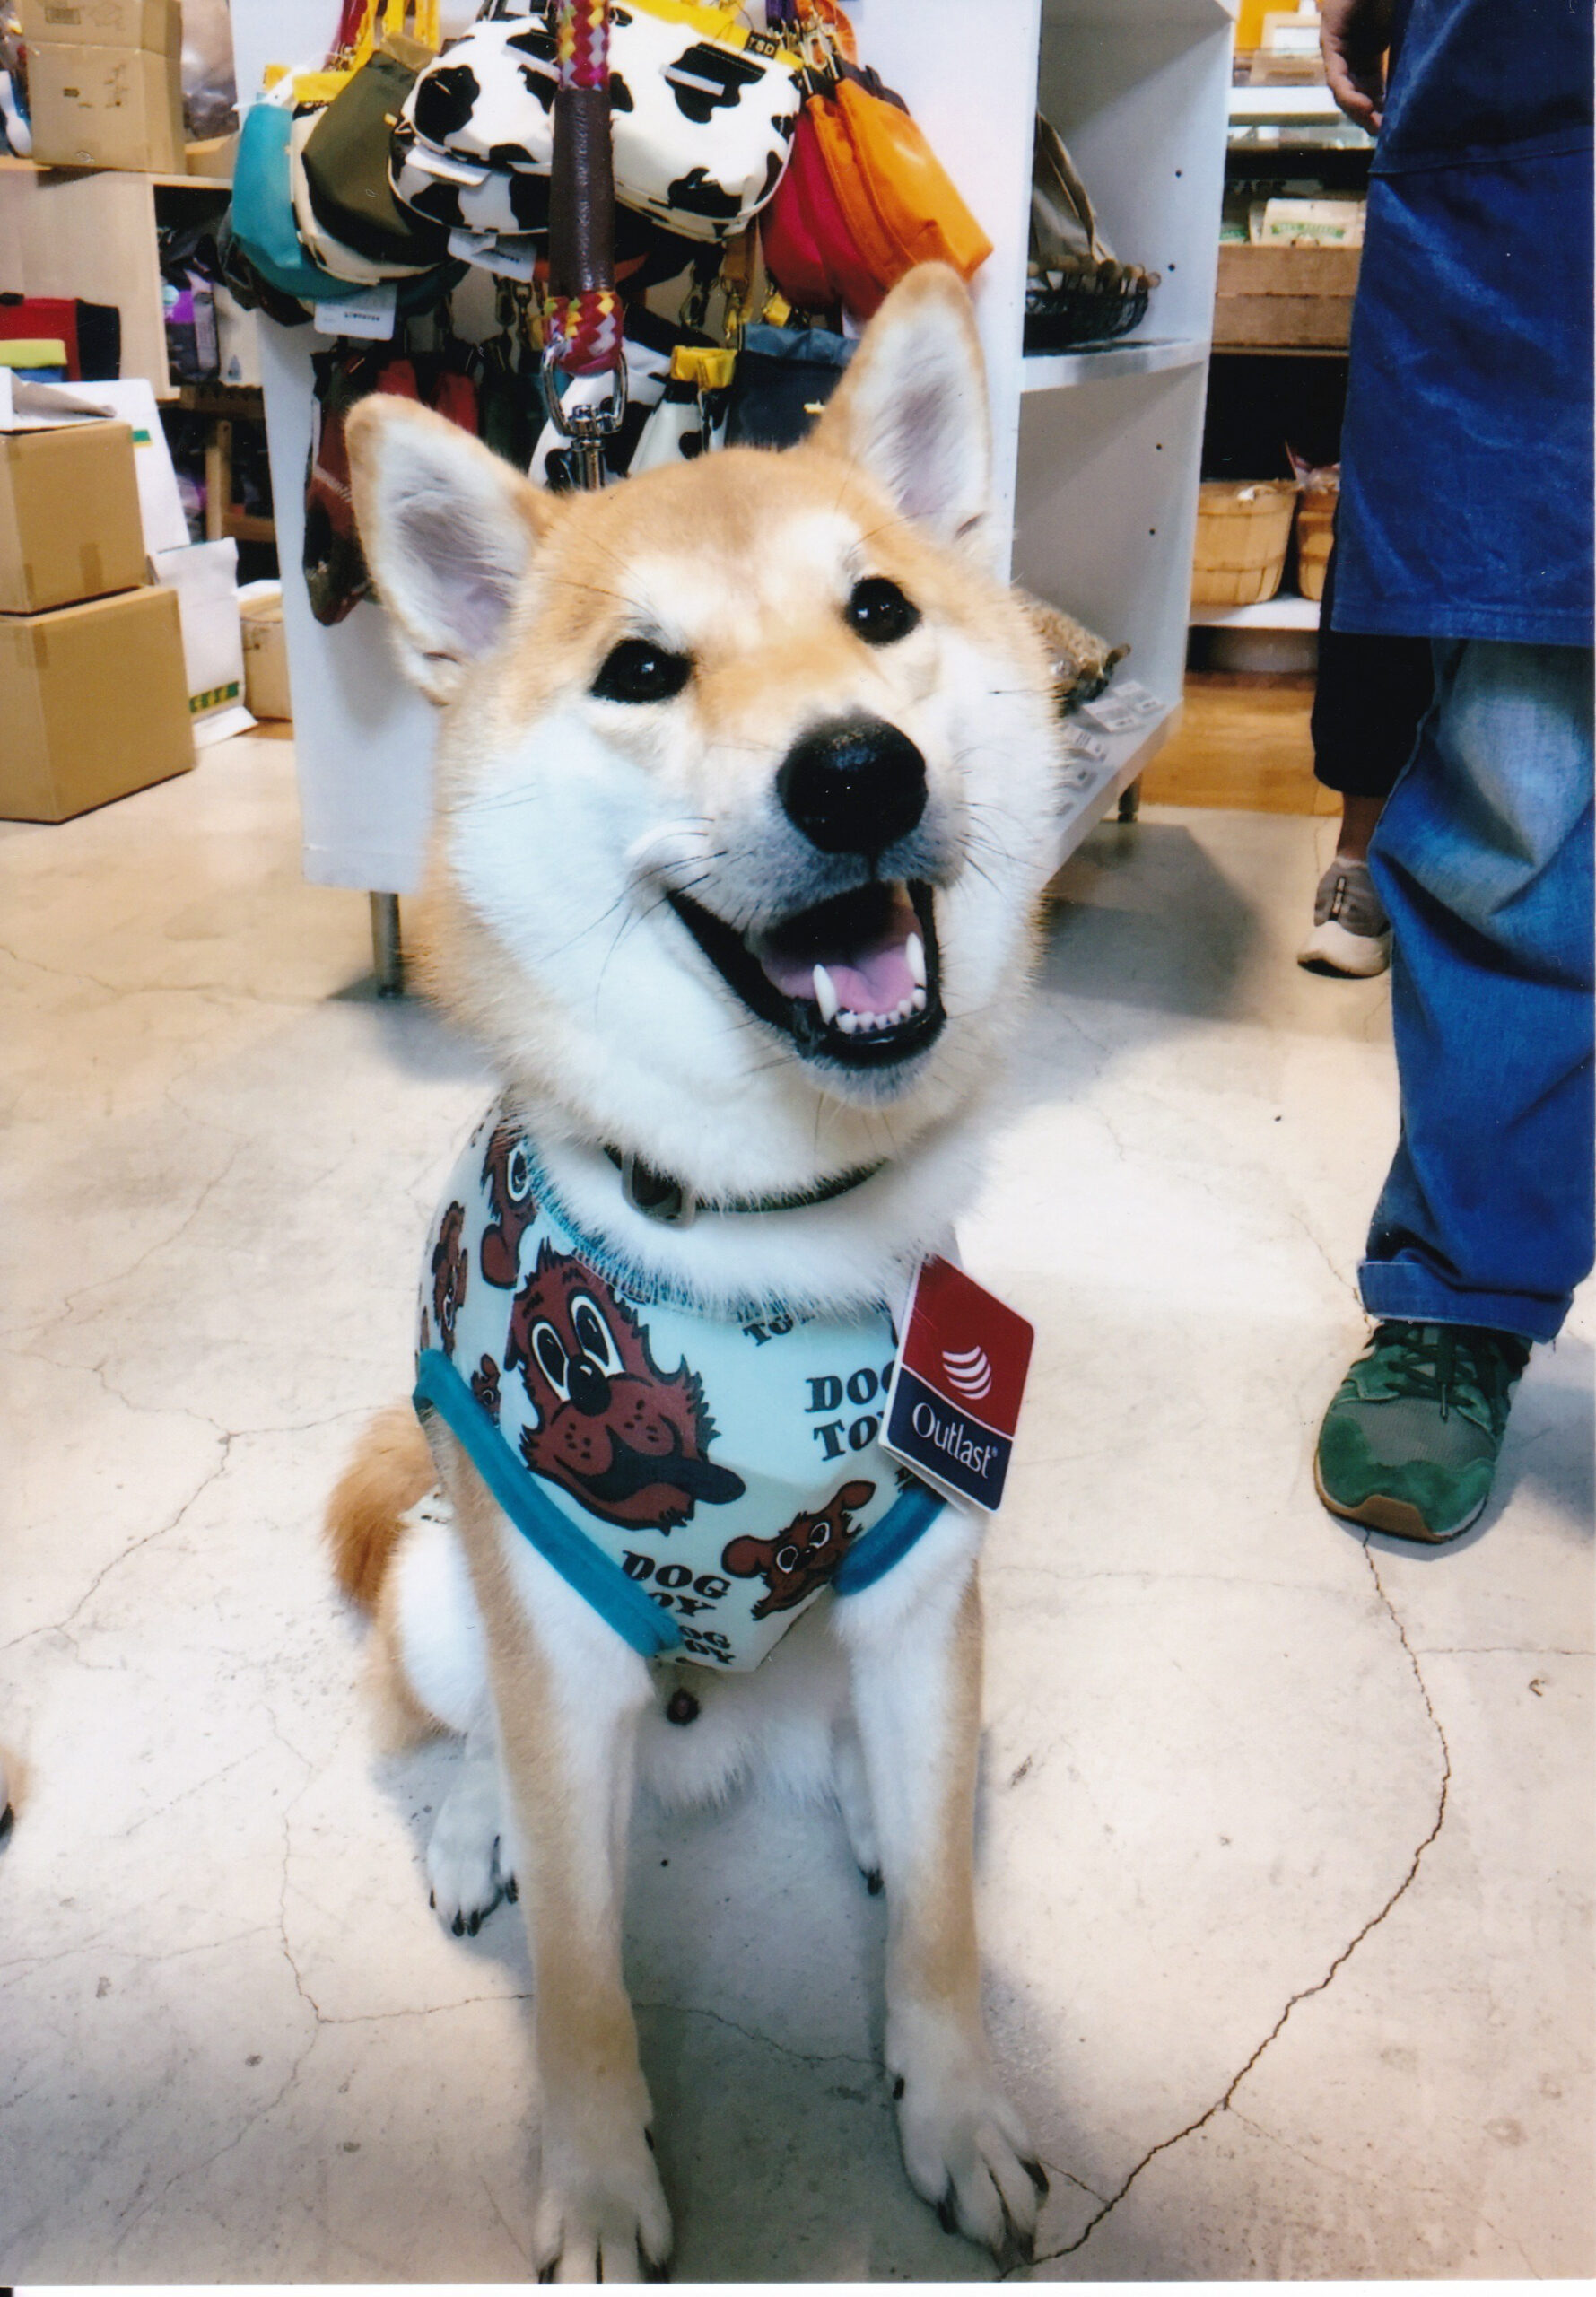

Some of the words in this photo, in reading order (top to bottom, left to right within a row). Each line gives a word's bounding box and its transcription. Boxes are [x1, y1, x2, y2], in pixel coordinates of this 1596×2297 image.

[813, 1411, 885, 1462] TO
[623, 1550, 731, 1599] DOG
[648, 1592, 716, 1617] OY
[679, 1625, 730, 1649] OG
[684, 1639, 736, 1665] OY
